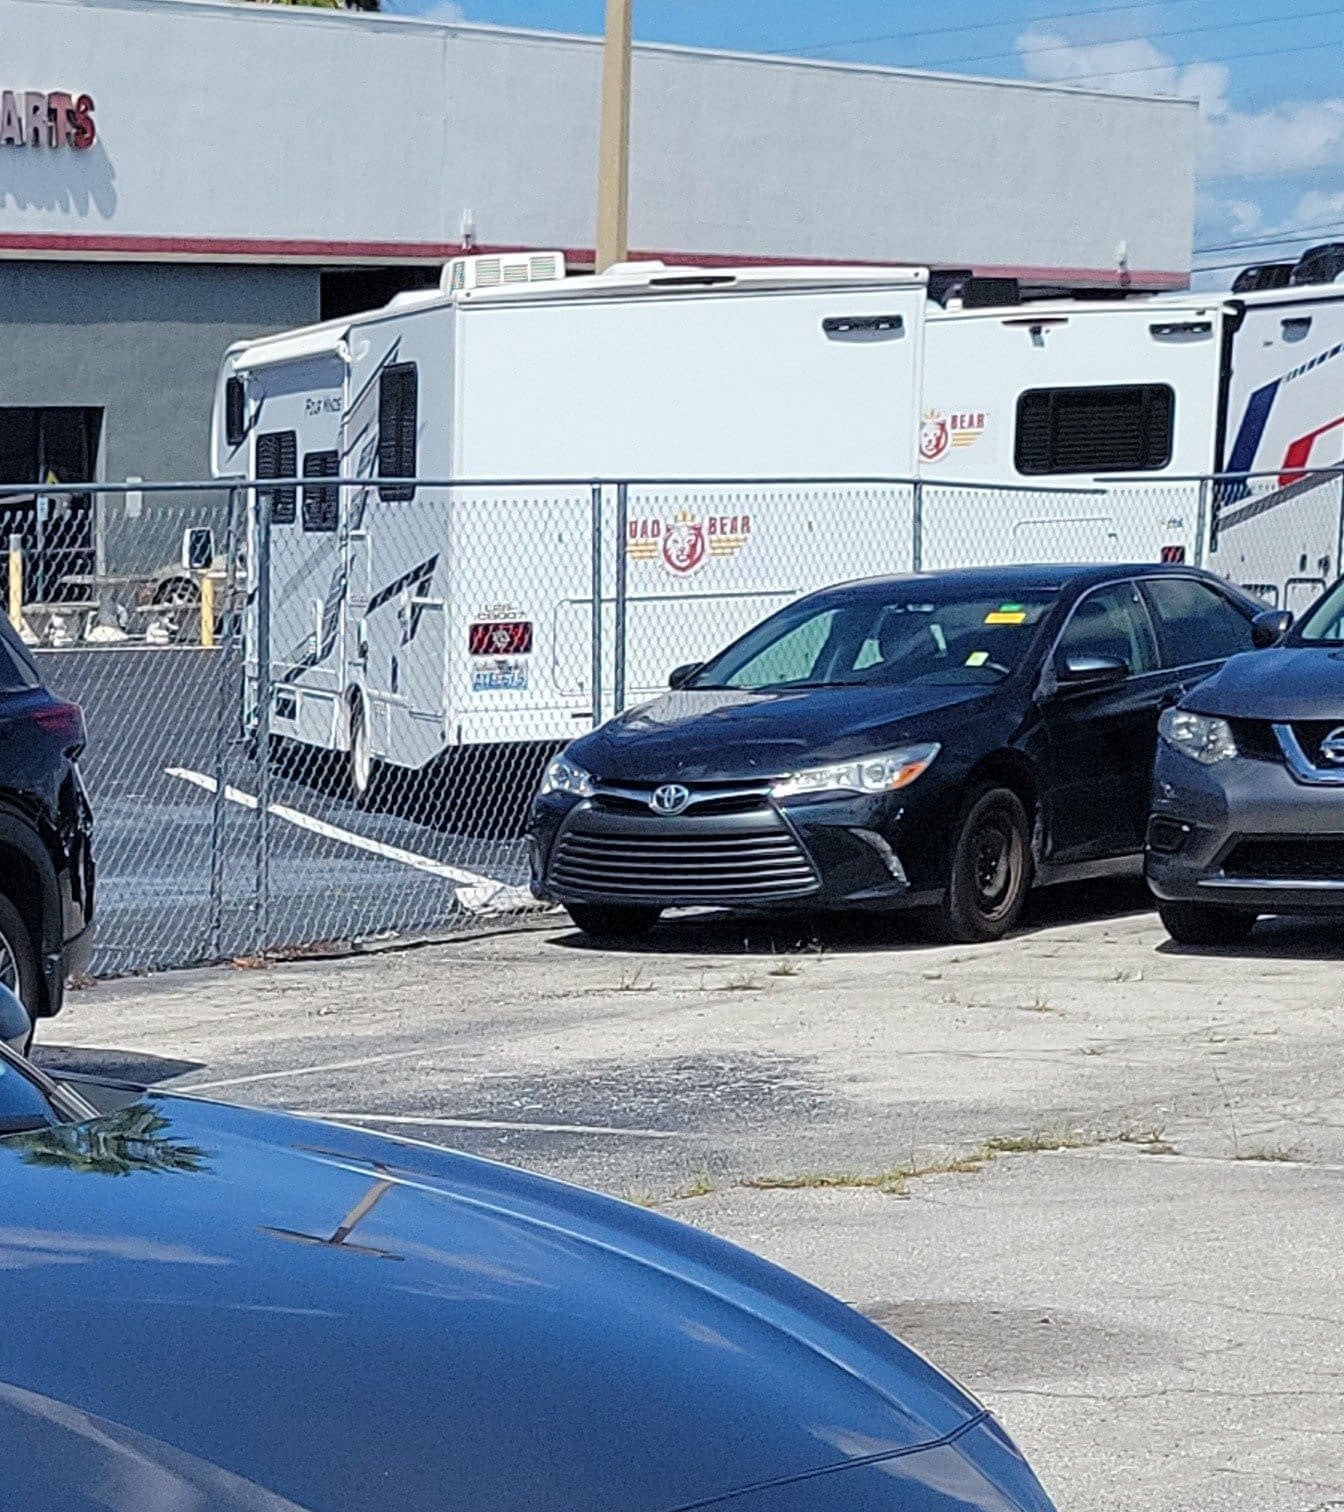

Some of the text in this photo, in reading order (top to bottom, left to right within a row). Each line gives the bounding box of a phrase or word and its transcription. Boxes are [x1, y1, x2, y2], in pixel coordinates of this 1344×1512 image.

[950, 413, 985, 430] BEAR
[628, 515, 751, 539] OAD BEAR
